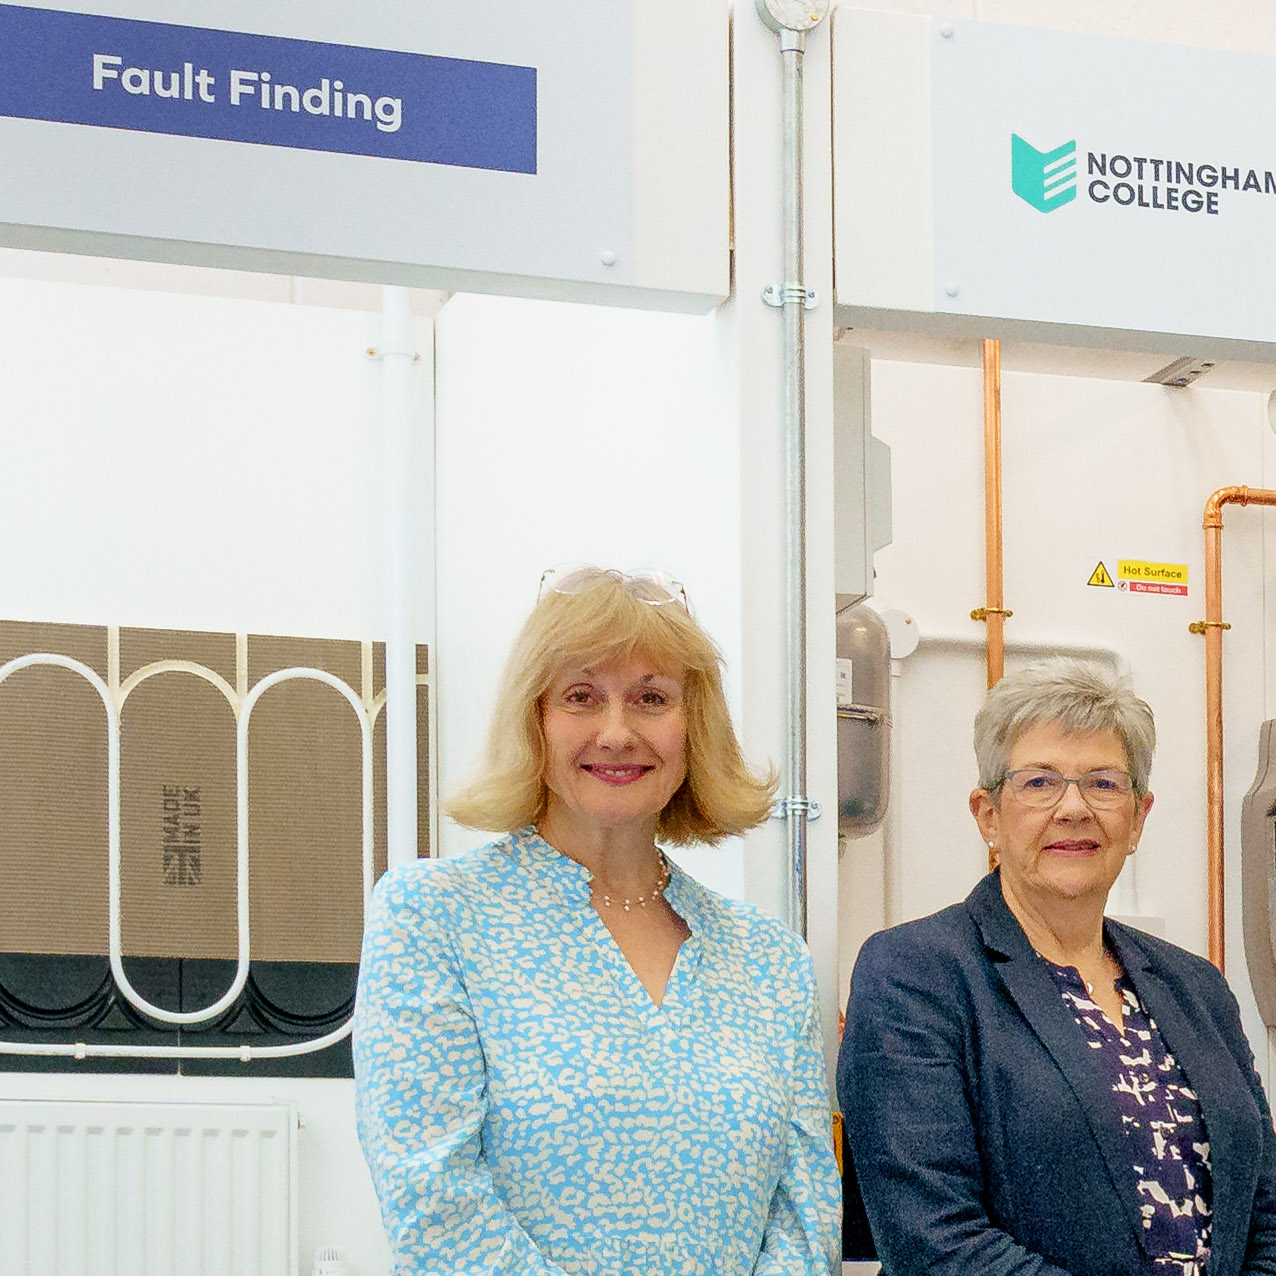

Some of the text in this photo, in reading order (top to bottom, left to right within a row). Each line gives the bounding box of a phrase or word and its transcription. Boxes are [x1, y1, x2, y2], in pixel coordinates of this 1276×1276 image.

[93, 53, 403, 132] Fault Finding
[1087, 179, 1219, 215] COLLEGE
[1123, 565, 1183, 578] Hot Surface
[162, 784, 180, 843] MADE
[183, 822, 200, 844] IN
